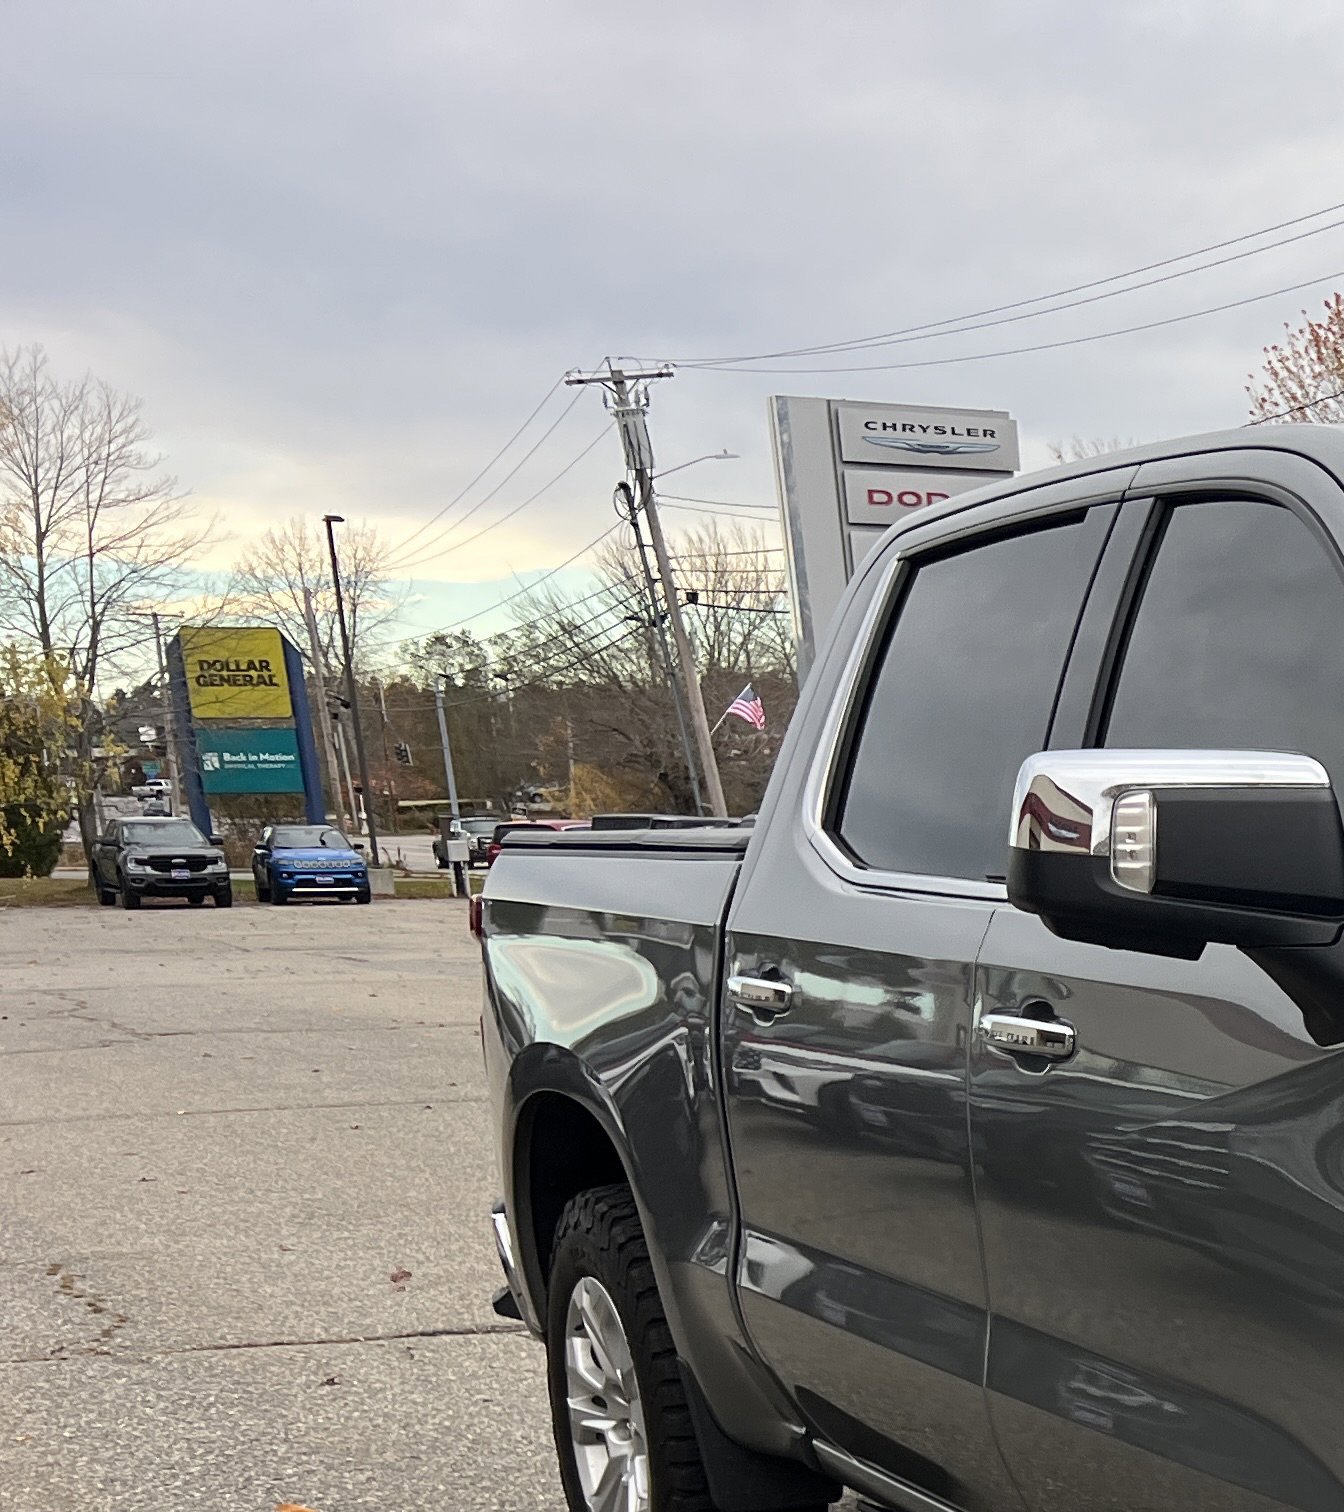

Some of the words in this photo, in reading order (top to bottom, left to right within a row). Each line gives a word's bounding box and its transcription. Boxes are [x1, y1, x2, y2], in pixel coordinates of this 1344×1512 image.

[864, 421, 997, 439] CHRYSLER
[867, 489, 950, 507] DOD
[199, 659, 271, 672] DOLLAR
[196, 674, 280, 687] GENERAL
[222, 752, 247, 761] Back
[259, 752, 295, 761] Motion
